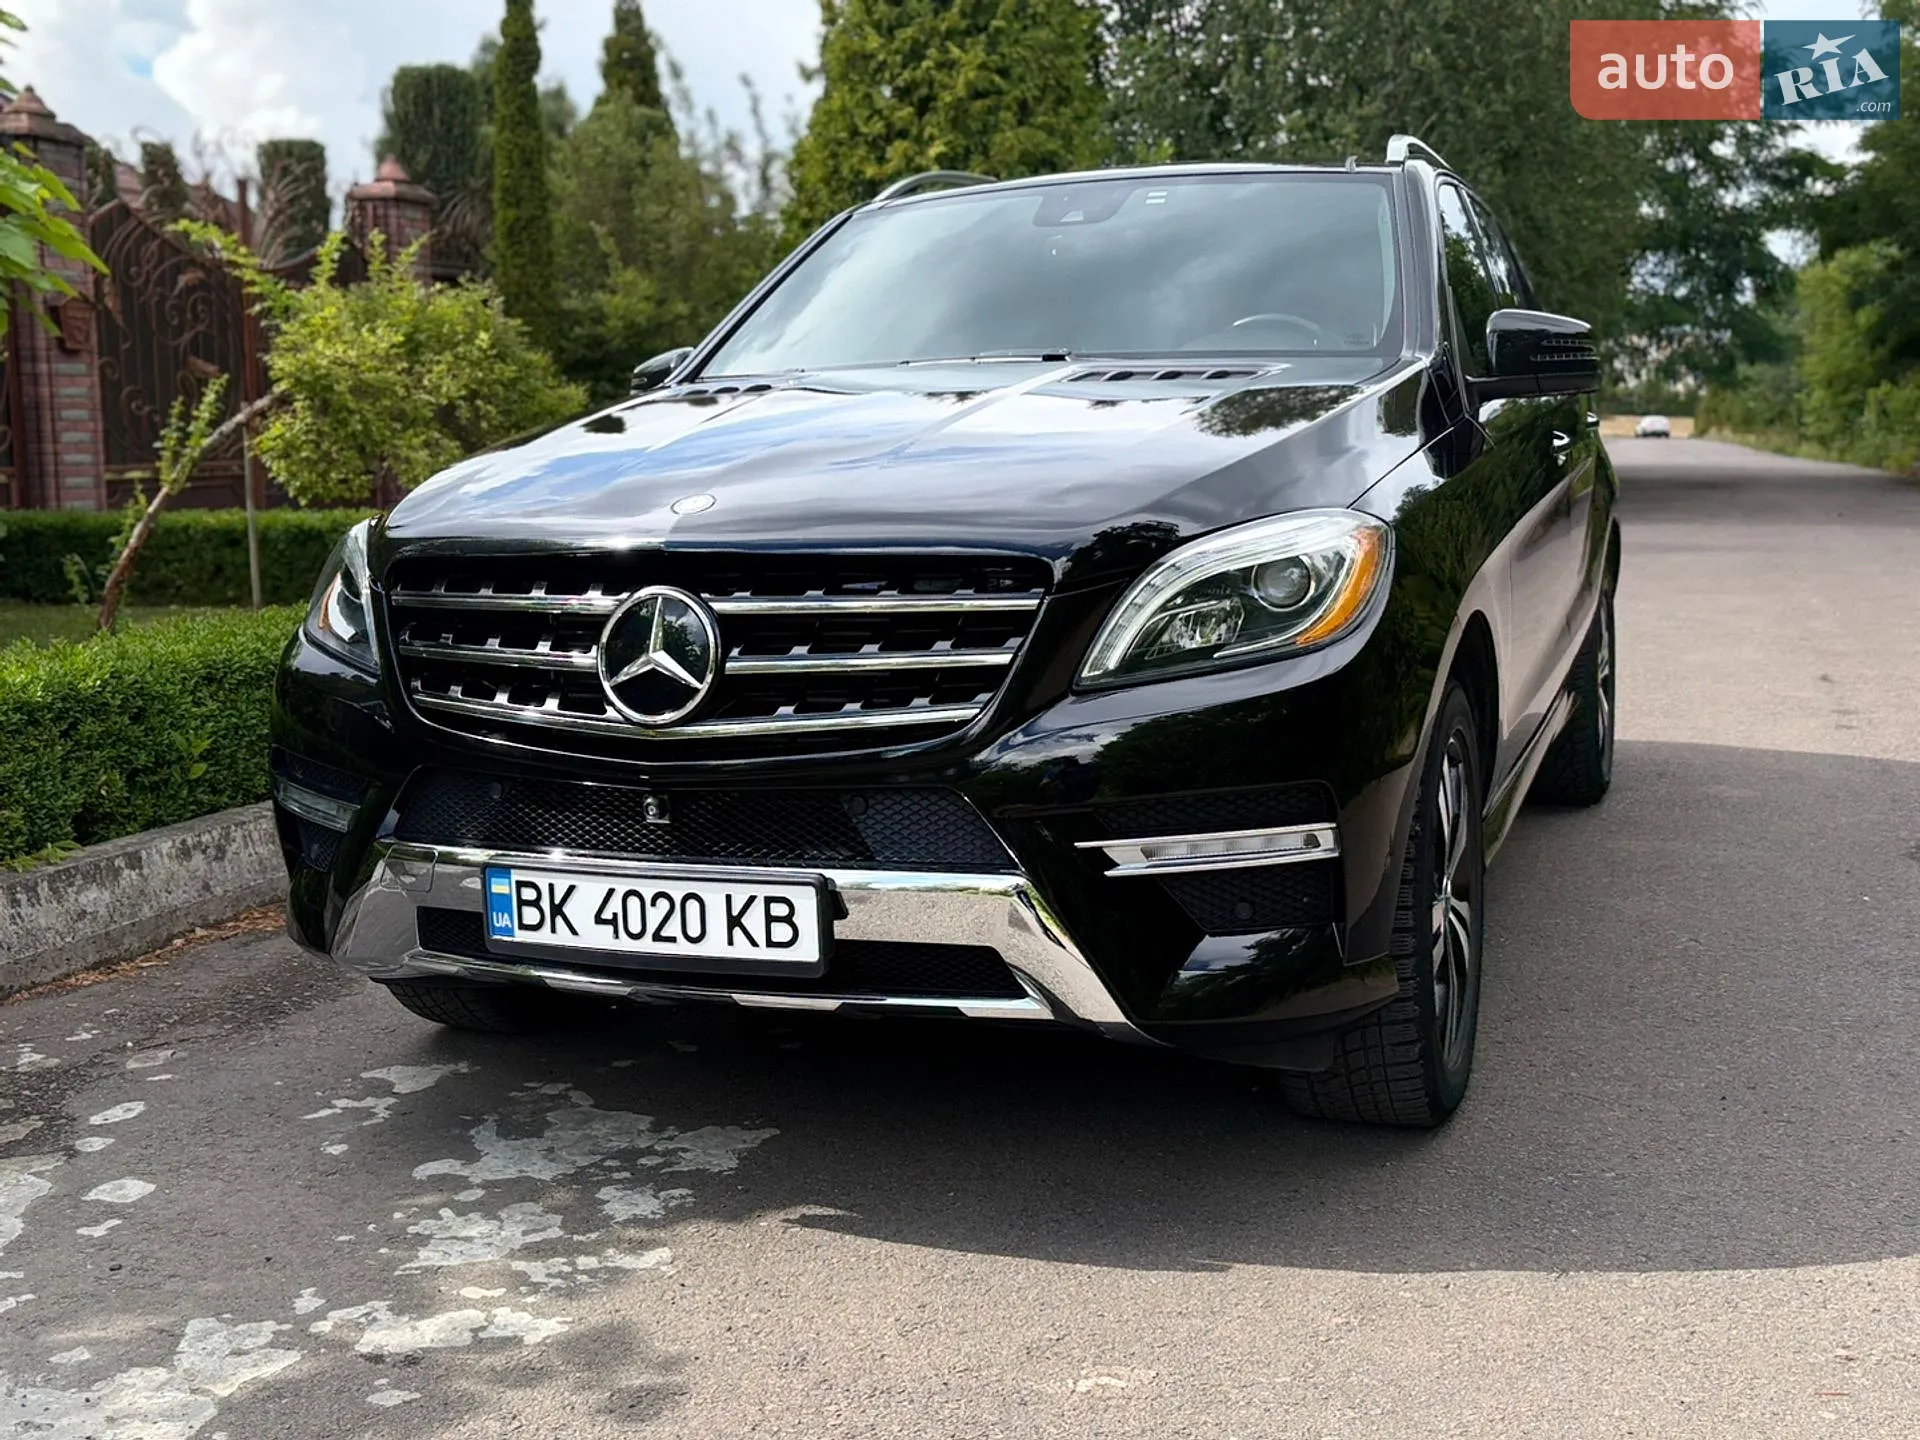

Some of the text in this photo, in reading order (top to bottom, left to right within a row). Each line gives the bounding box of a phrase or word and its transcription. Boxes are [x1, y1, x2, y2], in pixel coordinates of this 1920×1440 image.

[493, 912, 512, 927] UA
[515, 880, 800, 949] BK 4020 KB
